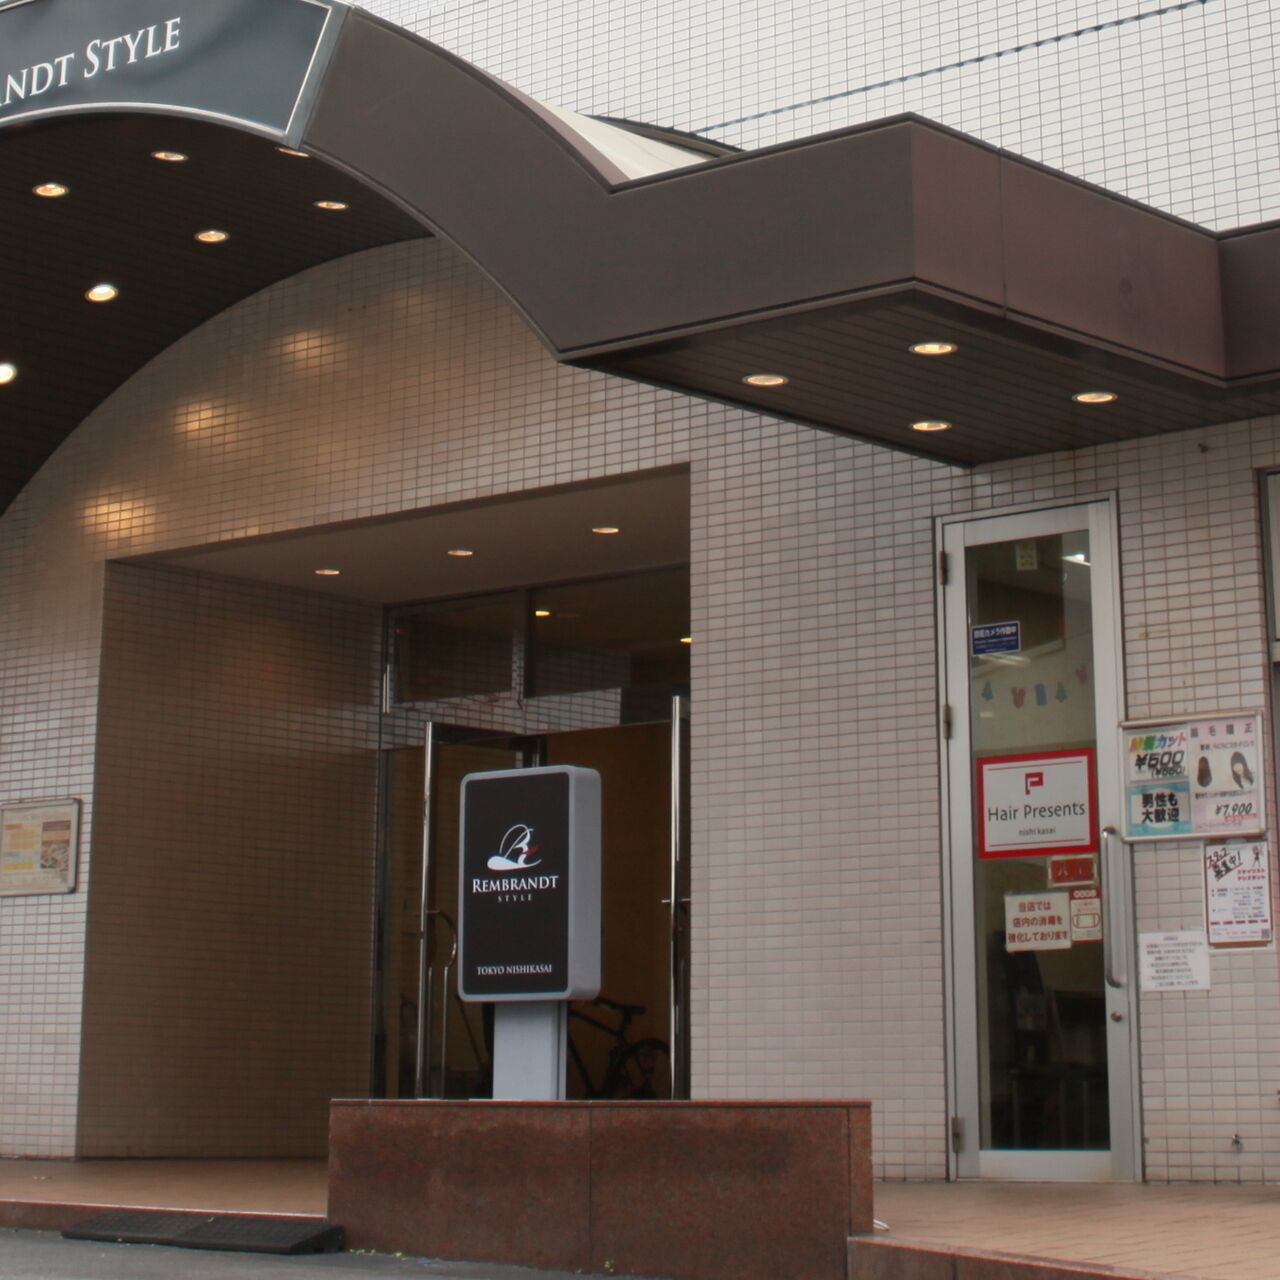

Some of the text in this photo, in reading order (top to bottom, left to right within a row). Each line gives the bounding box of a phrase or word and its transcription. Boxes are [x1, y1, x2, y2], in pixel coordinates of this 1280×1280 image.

[82, 17, 182, 78] STYLE
[1141, 792, 1178, 808] 男性も
[987, 805, 1019, 821] Hair
[1019, 826, 1056, 836] nishi kasai
[472, 875, 559, 893] REMBRANDT
[497, 893, 533, 903] STYLE
[1018, 901, 1052, 913] 当店では
[476, 963, 552, 976] TOKYO NISHIKASAI
